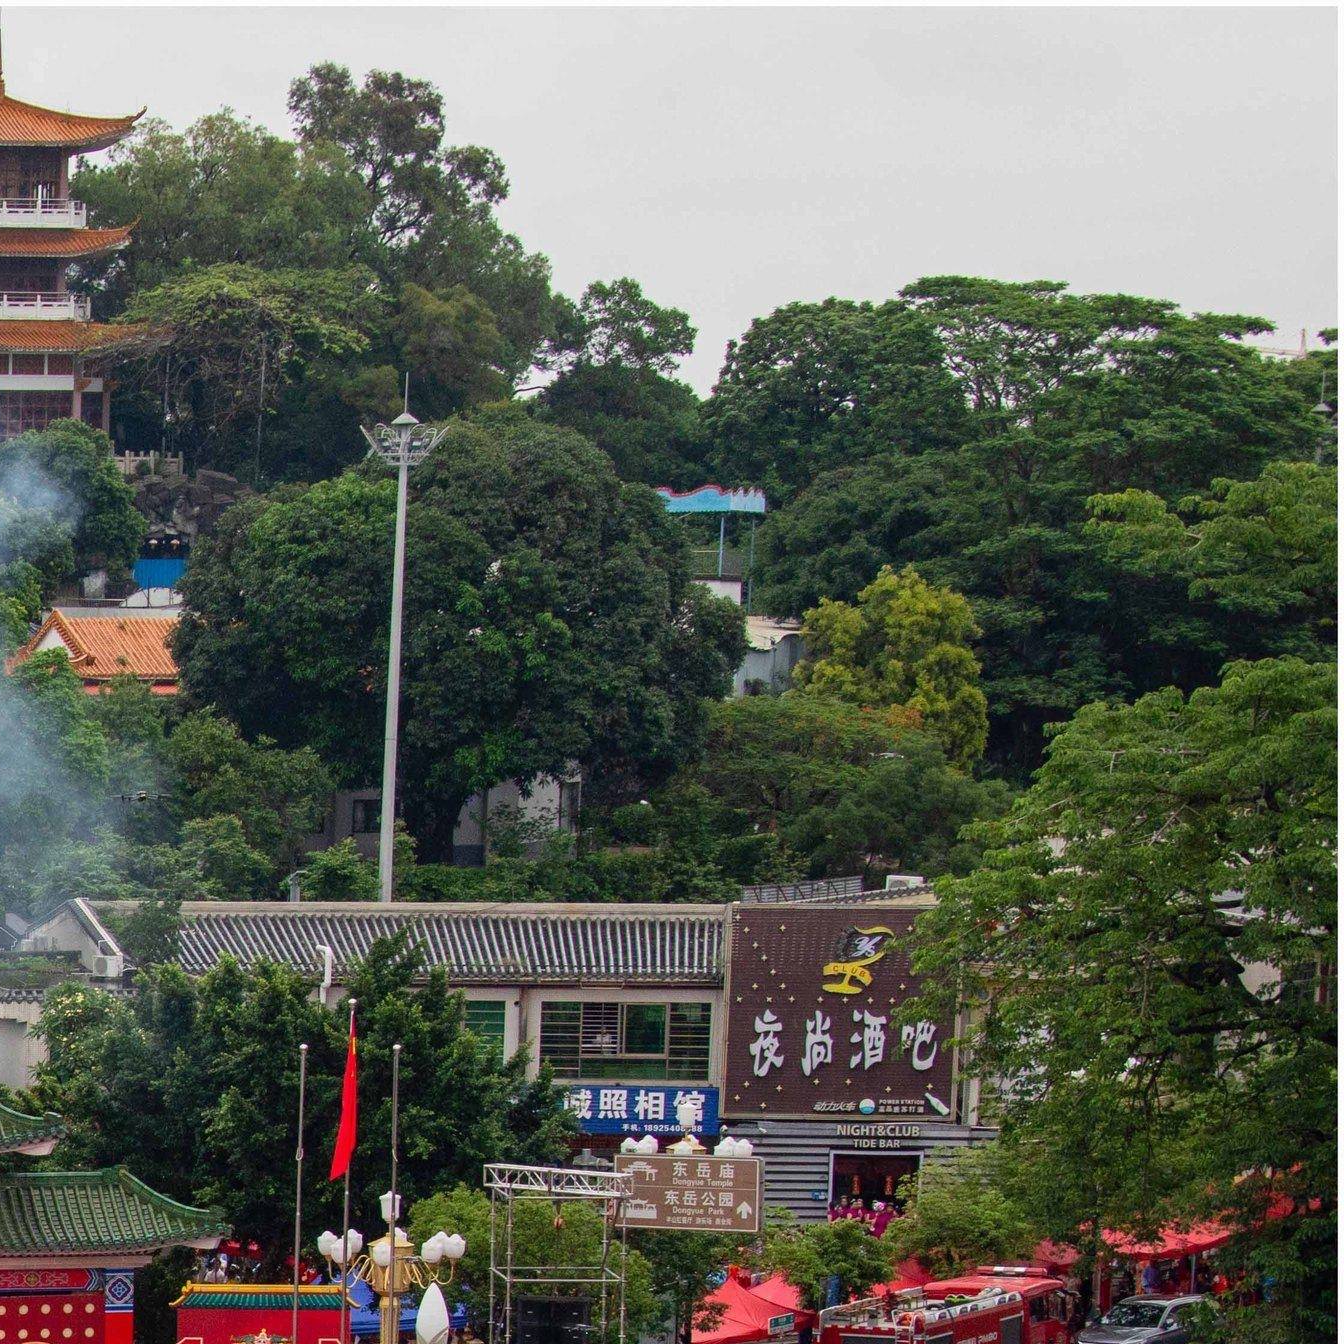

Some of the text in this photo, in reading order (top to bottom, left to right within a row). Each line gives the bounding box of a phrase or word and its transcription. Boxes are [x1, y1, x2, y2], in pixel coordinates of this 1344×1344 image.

[832, 965, 868, 978] CLUB
[749, 1009, 937, 1077] 夜尚酒吧
[837, 1124, 920, 1137] NIGHT&CLUB
[853, 1139, 901, 1148] TIDE BAR
[672, 1162, 734, 1179] 东岳庙
[672, 1178, 734, 1187] Dongyue Temple
[664, 1190, 734, 1207] 东岳公园
[672, 1207, 724, 1216] Dongyue Park
